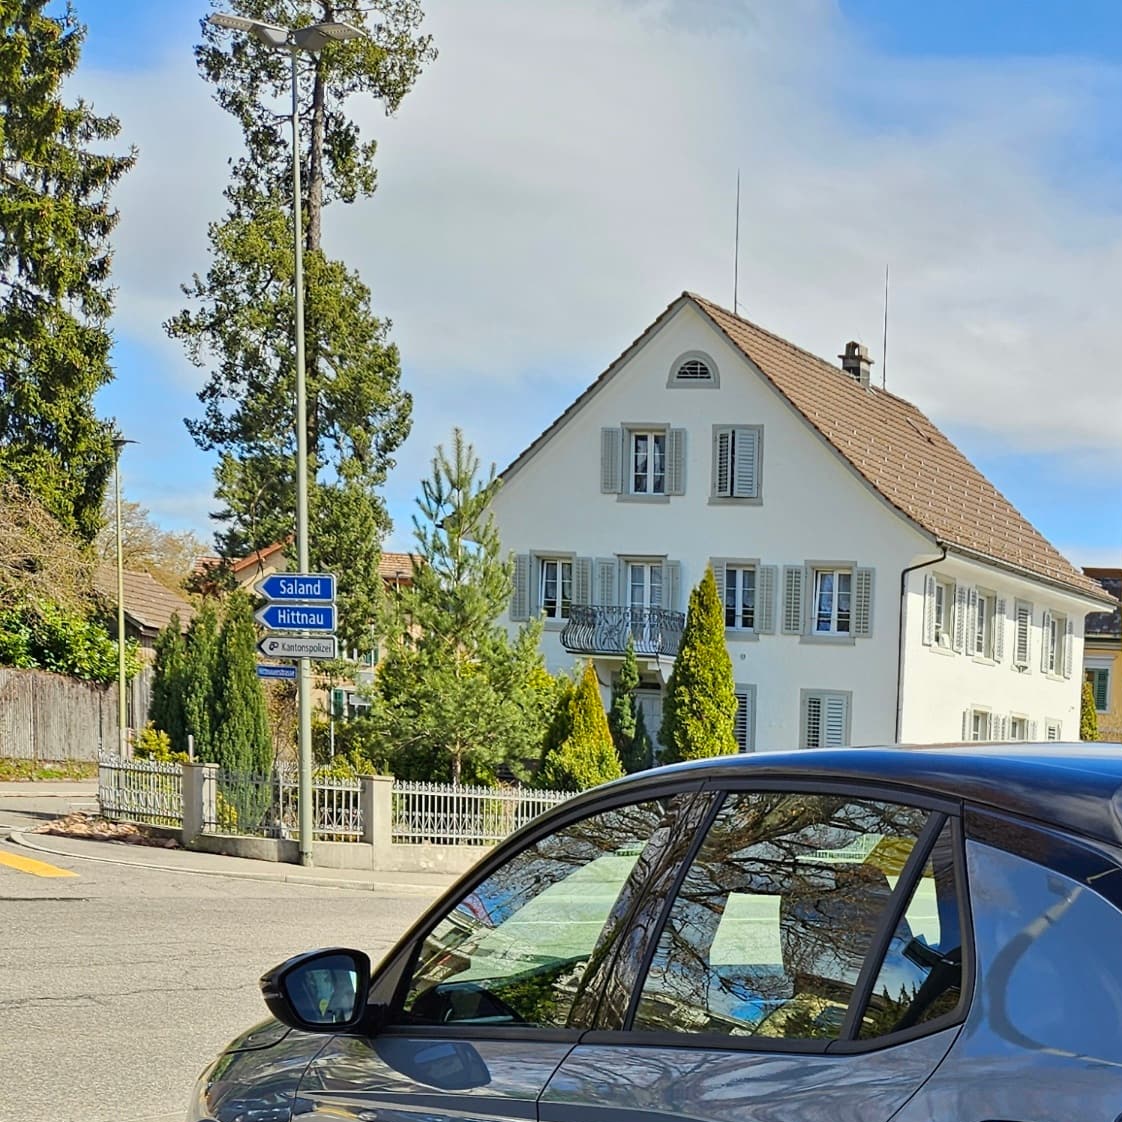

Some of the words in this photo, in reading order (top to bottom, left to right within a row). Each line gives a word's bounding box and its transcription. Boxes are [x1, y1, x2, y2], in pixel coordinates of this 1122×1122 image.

[280, 579, 321, 595] Saland
[277, 609, 324, 625] Hittnau
[281, 642, 332, 654] Kantonspolizei
